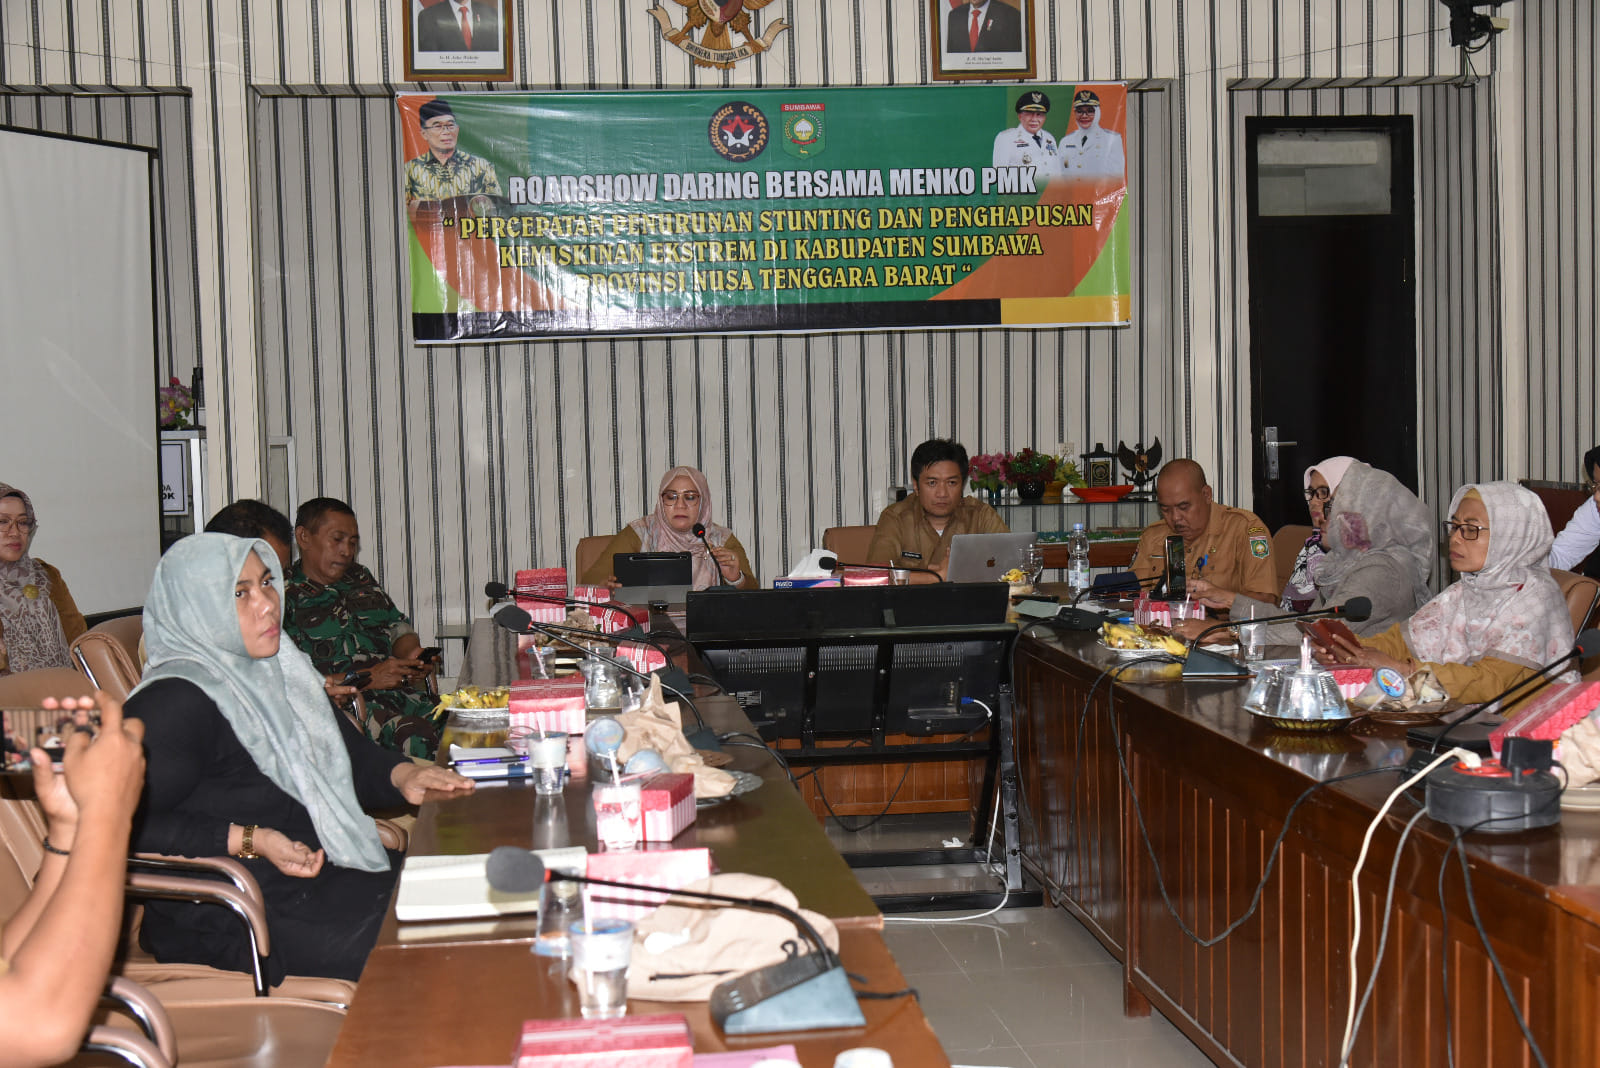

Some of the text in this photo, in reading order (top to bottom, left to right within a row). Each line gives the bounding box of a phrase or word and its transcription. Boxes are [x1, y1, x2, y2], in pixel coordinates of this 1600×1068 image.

[783, 104, 822, 112] SUMBAWA
[509, 165, 1037, 204] ROADSHOW DARING BERSAMA MENKO PMK
[460, 214, 605, 240] PERCEPATAN
[611, 211, 754, 236] PENURUNAN
[760, 208, 872, 232] STUNTING
[878, 207, 924, 230] DAN
[929, 204, 1094, 228] PENGHAPUSAN
[500, 234, 1044, 268] KEMISKINAN EKSTREM DI KABUPATEN SUMBAWA
[693, 268, 754, 292] NUSA
[760, 264, 879, 290] TENGGARA
[884, 263, 957, 287] BARAT
